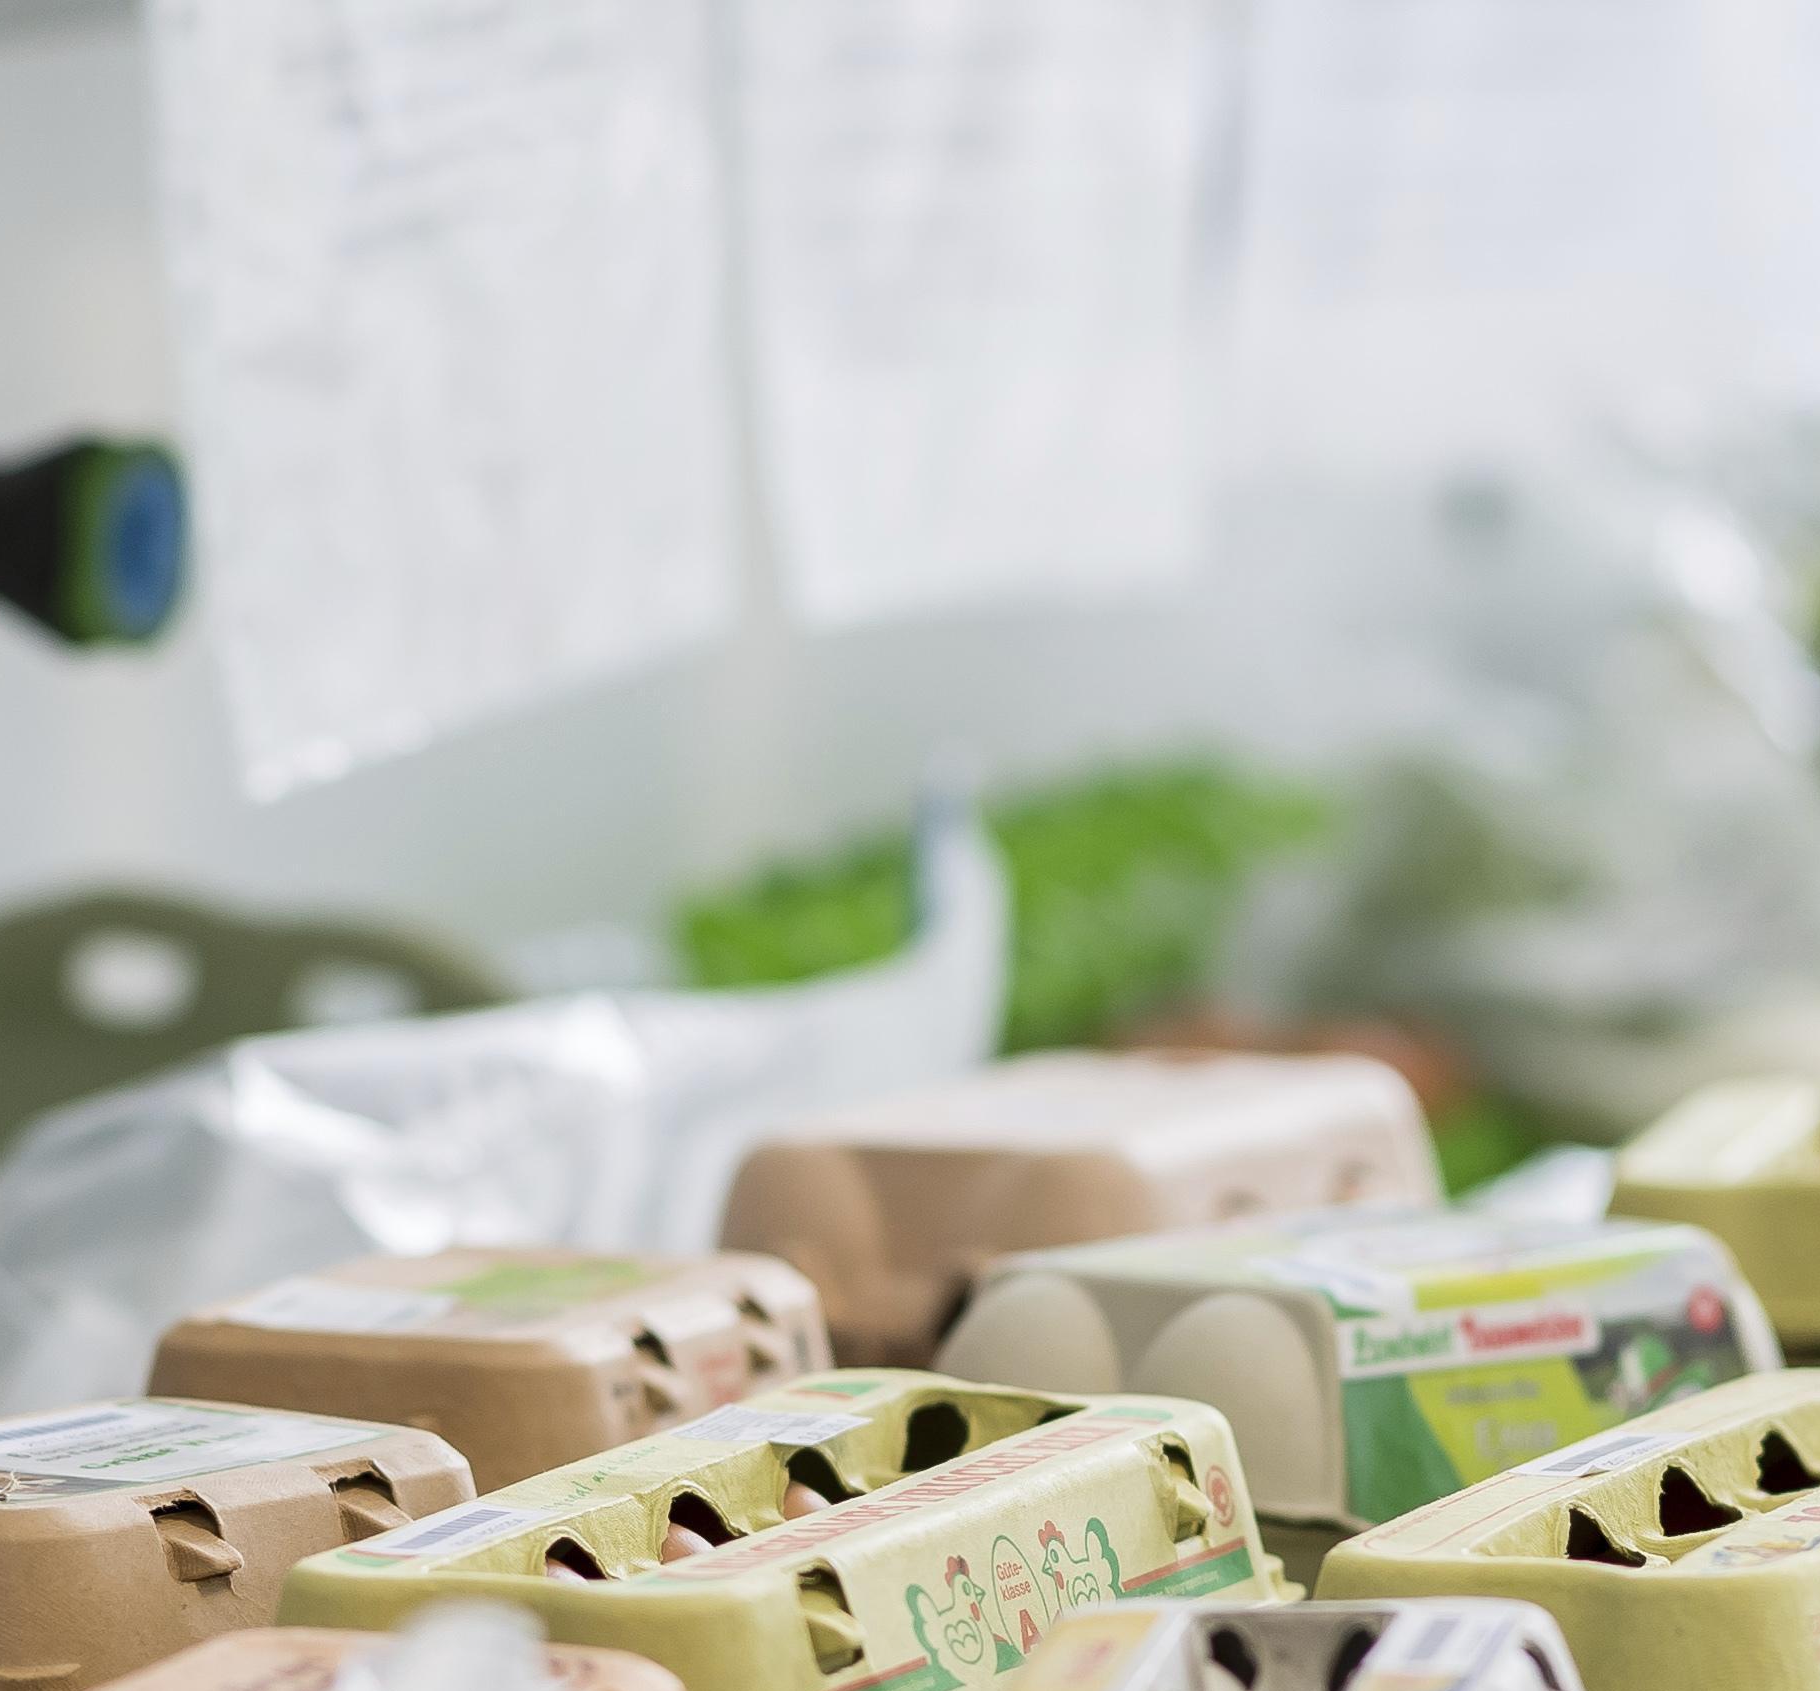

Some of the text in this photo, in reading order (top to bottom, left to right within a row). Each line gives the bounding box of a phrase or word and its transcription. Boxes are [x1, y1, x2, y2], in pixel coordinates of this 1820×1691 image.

[877, 1452, 1057, 1503] FRISCHE
[996, 1561, 1023, 1581] Güte-
[1000, 1580, 1032, 1602] klasse
[1019, 1608, 1044, 1655] A
